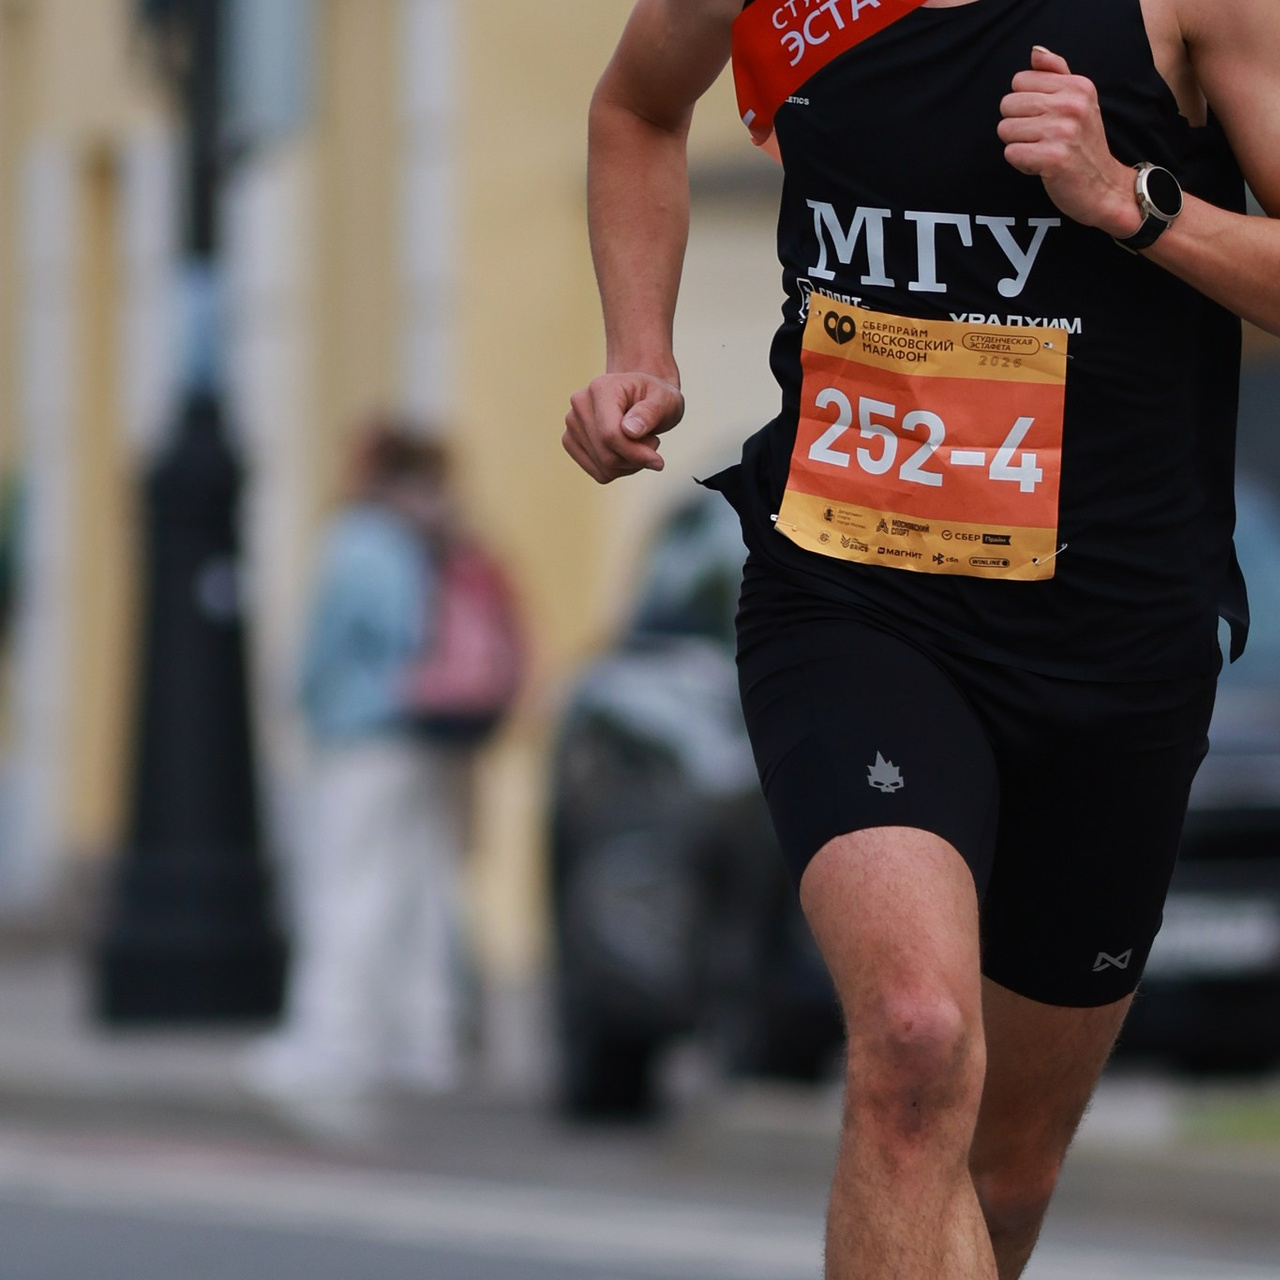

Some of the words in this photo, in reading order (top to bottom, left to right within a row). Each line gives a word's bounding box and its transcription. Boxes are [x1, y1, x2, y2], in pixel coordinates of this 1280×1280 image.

[806, 198, 1062, 298] МГУ
[862, 320, 928, 338] СБЕРПРАЙМ
[861, 331, 954, 352] МОСКОВСКИЙ
[969, 335, 1033, 346] СТУДЕНЧЕСКАЯ
[969, 341, 1011, 351] ЭСТАФЕТА
[862, 342, 927, 363] МАРАФОН
[808, 387, 1043, 494] 252-4
[954, 532, 981, 542] СБЕР
